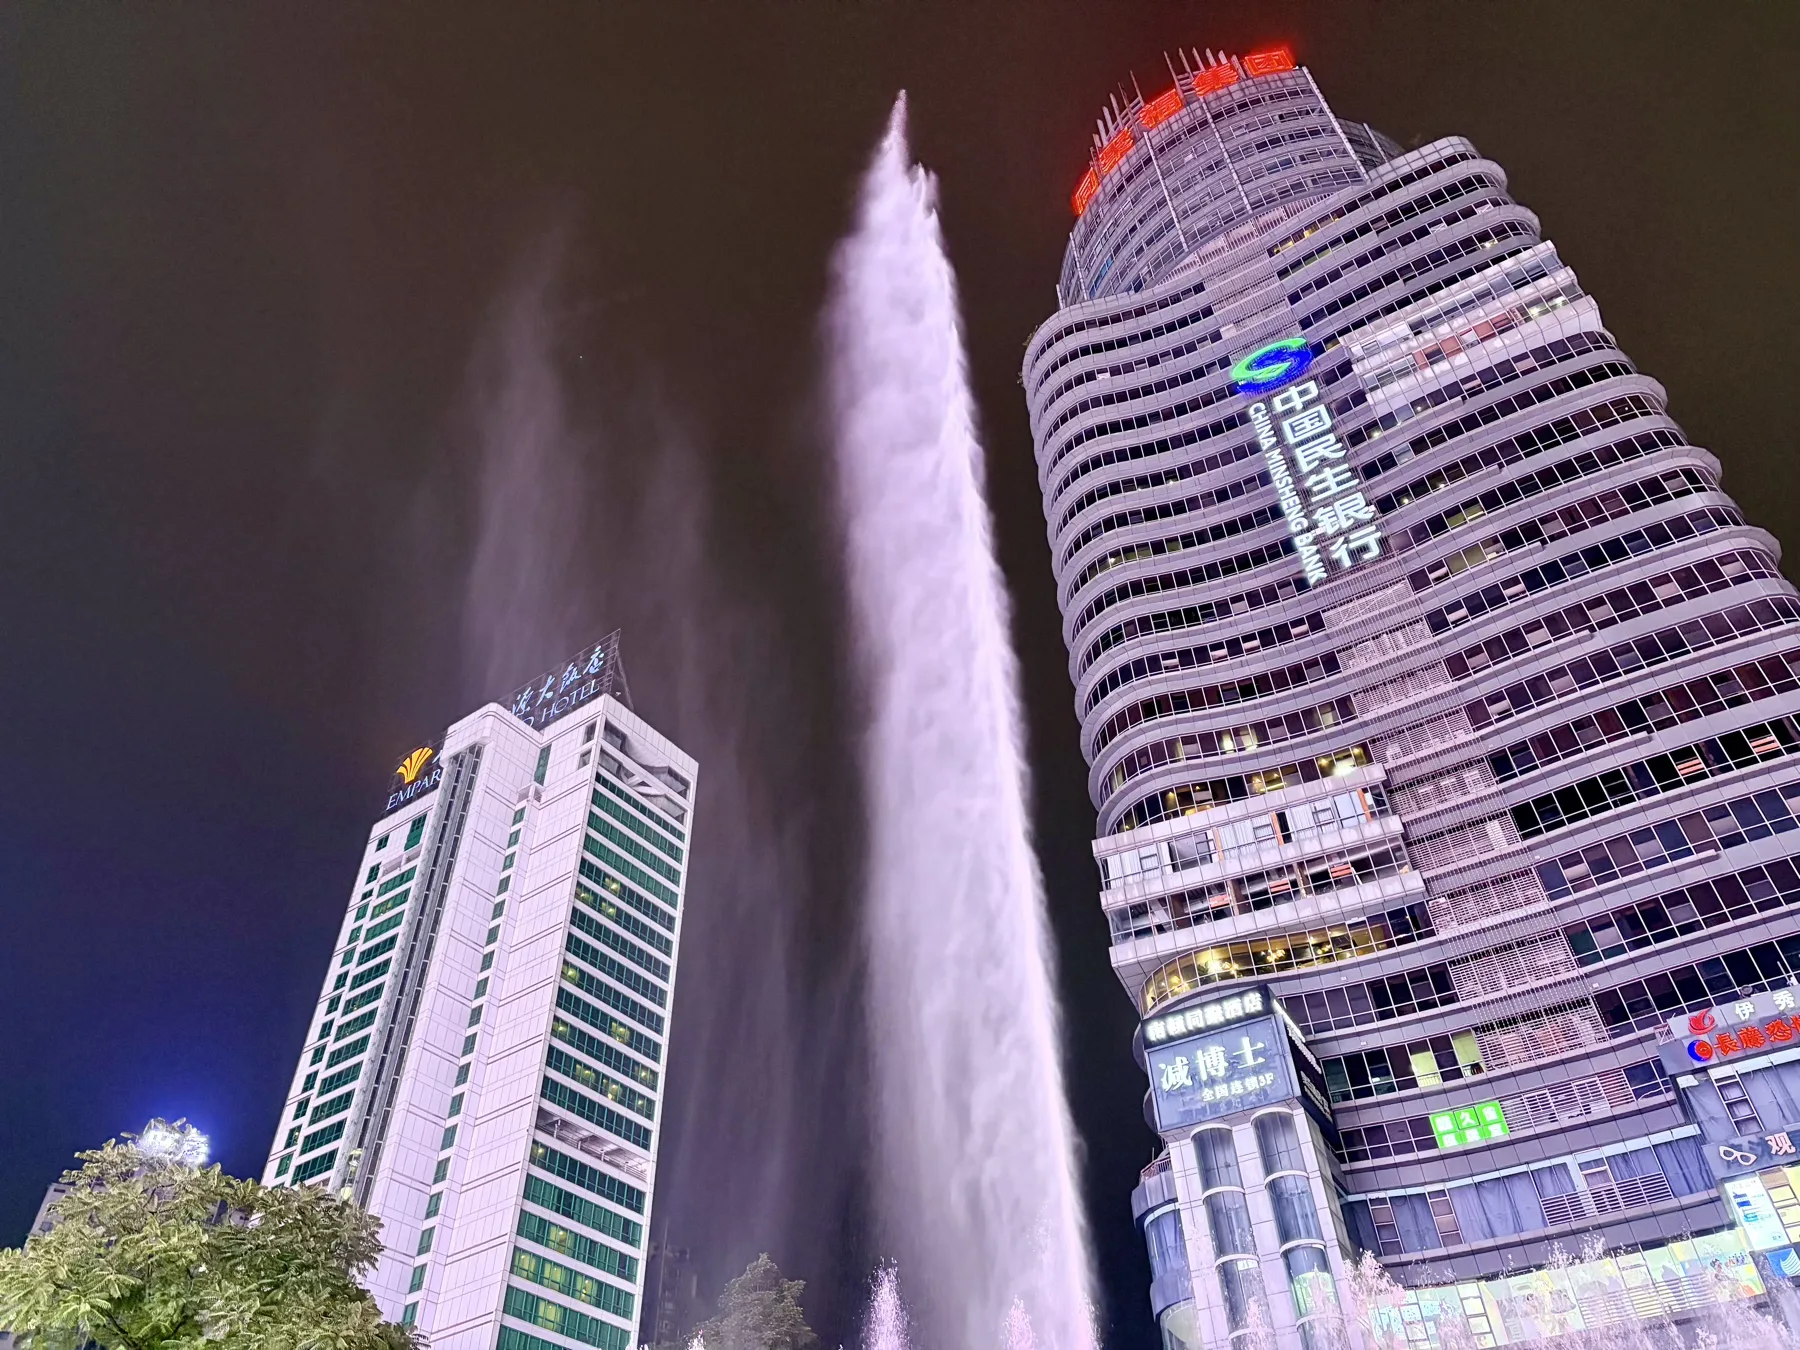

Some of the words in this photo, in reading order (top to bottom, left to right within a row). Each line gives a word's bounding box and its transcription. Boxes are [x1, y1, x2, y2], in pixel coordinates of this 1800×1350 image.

[1250, 402, 1277, 451] CHINA
[1265, 448, 1309, 533] MINSHENG
[1294, 532, 1328, 586] BANK
[1273, 381, 1382, 568] 中国民生银行
[541, 678, 600, 723] HOTEL
[1158, 1036, 1266, 1092] 减博士
